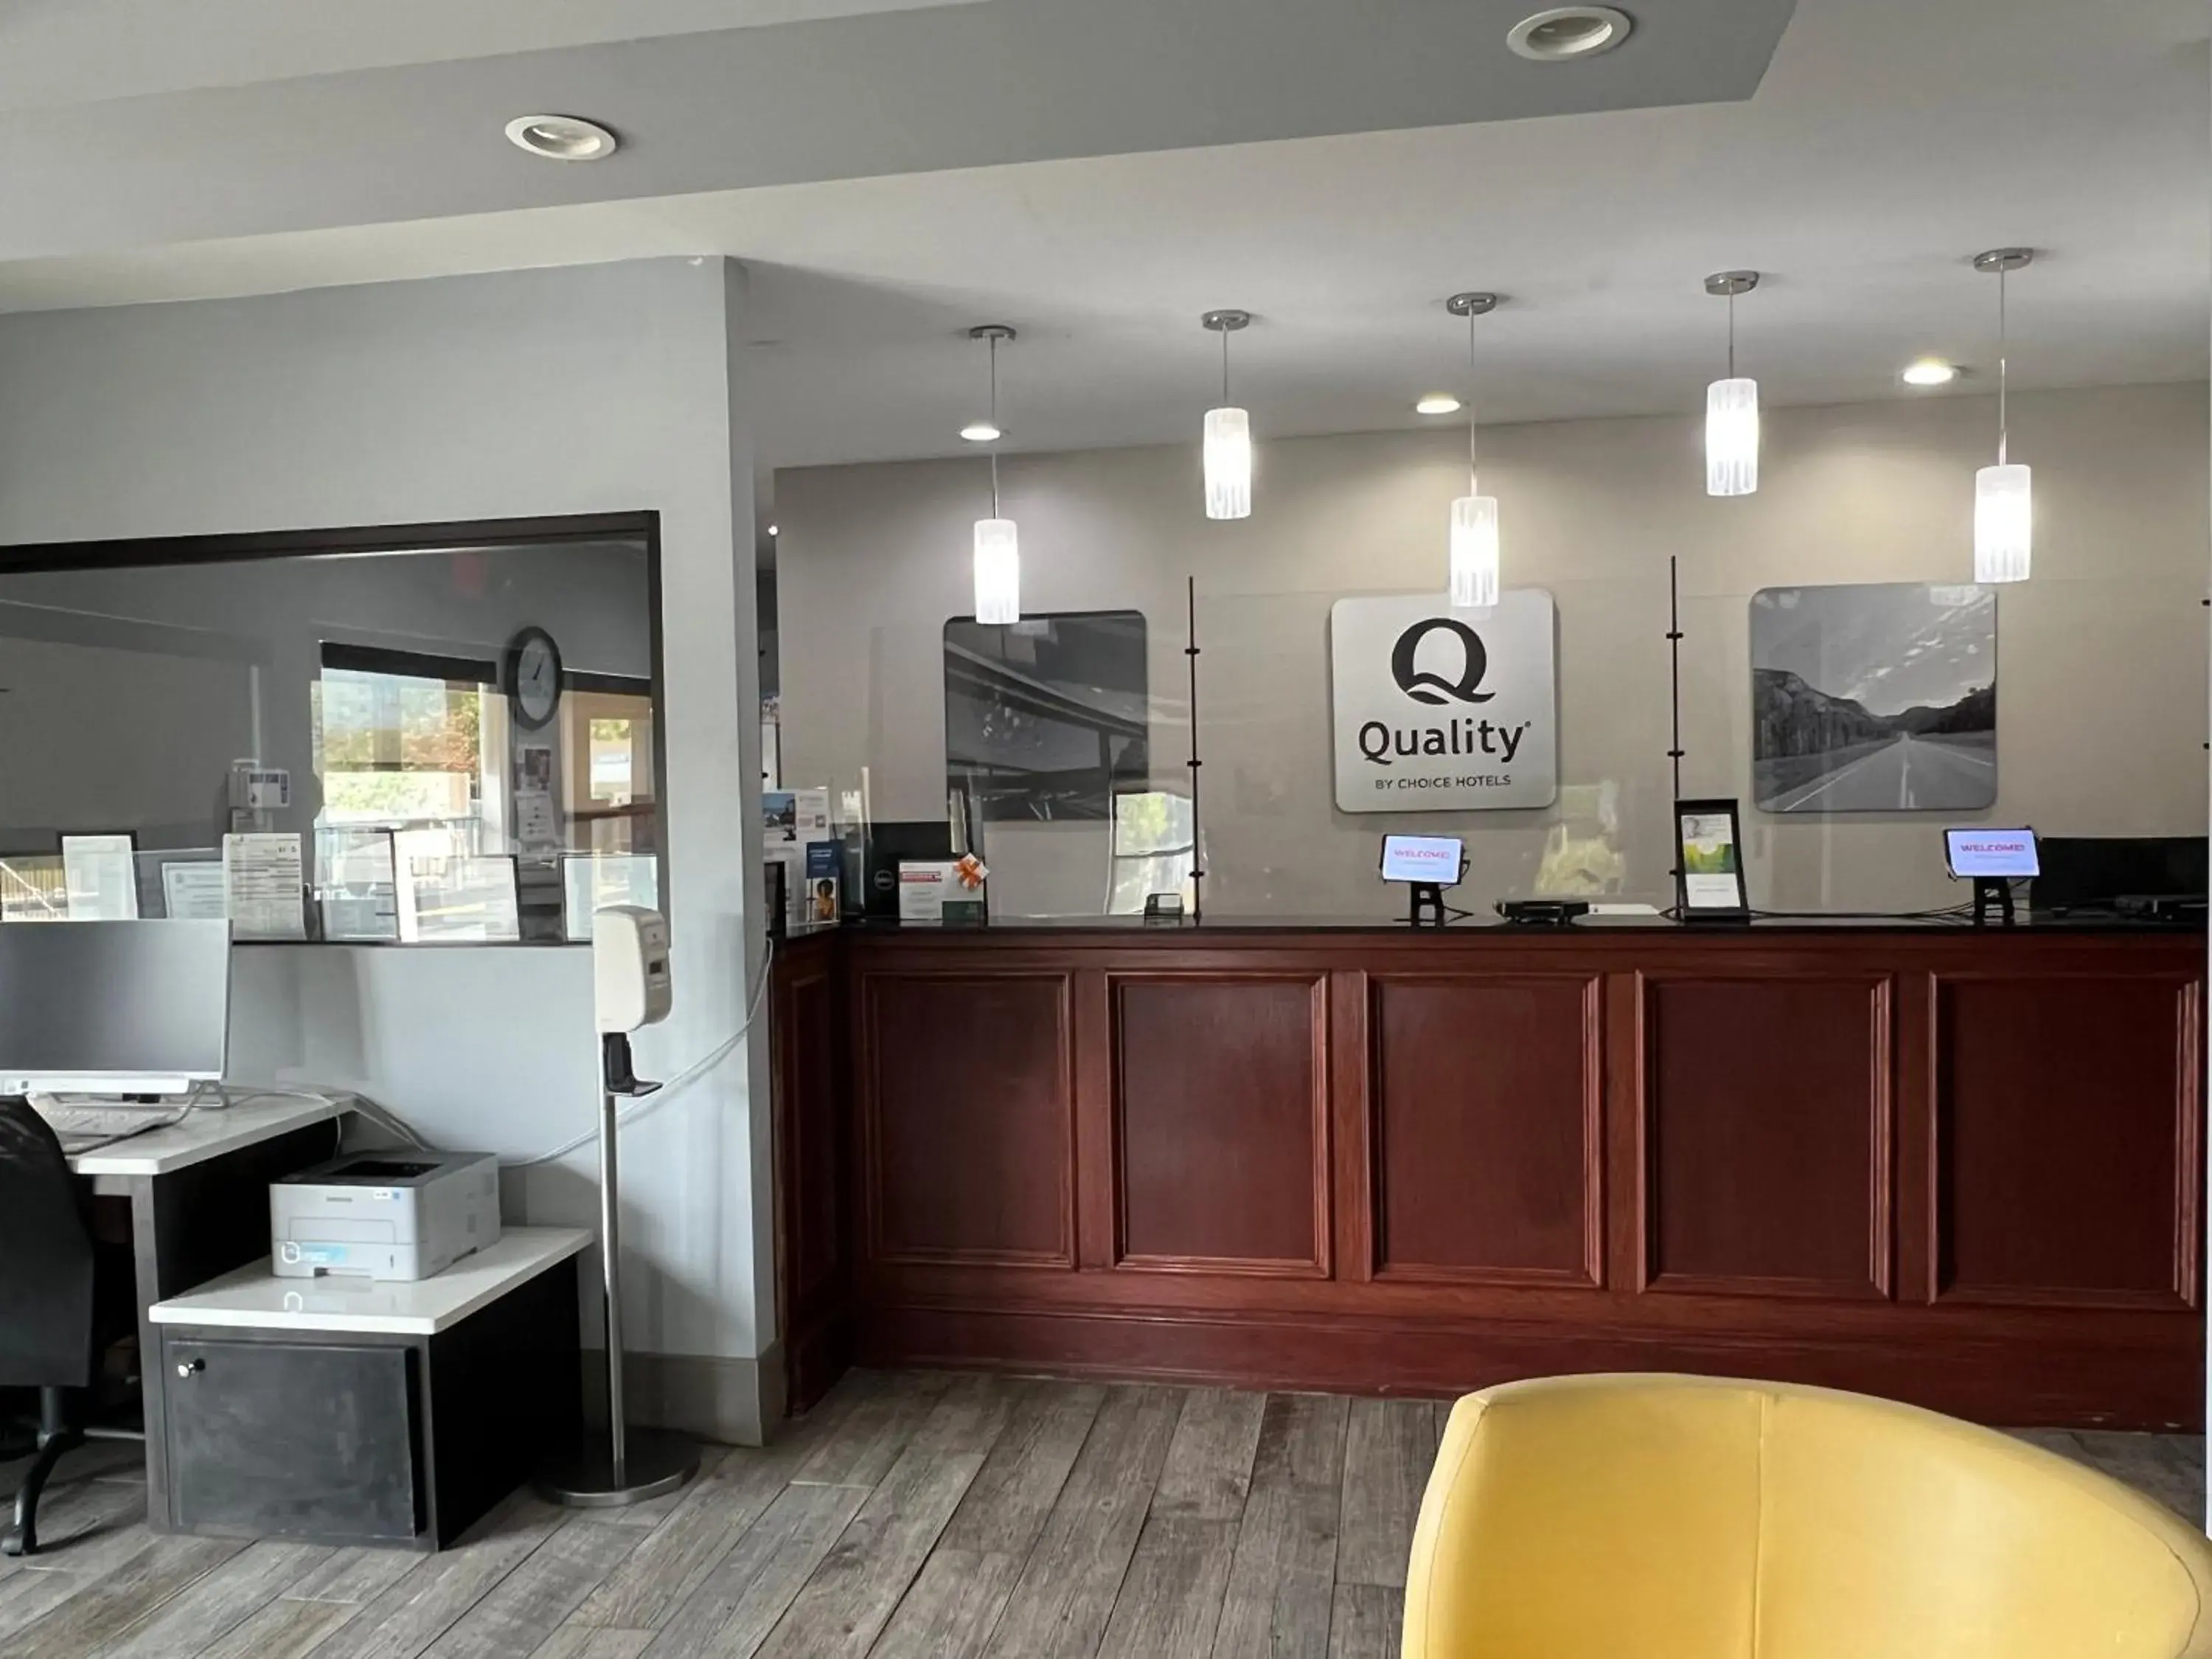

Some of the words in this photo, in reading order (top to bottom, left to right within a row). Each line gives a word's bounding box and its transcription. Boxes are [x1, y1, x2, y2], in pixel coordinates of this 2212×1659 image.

[1391, 617, 1496, 706] Q
[1375, 779, 1393, 790] BY
[1398, 776, 1452, 789] CHOICE
[1455, 774, 1512, 787] HOTELS
